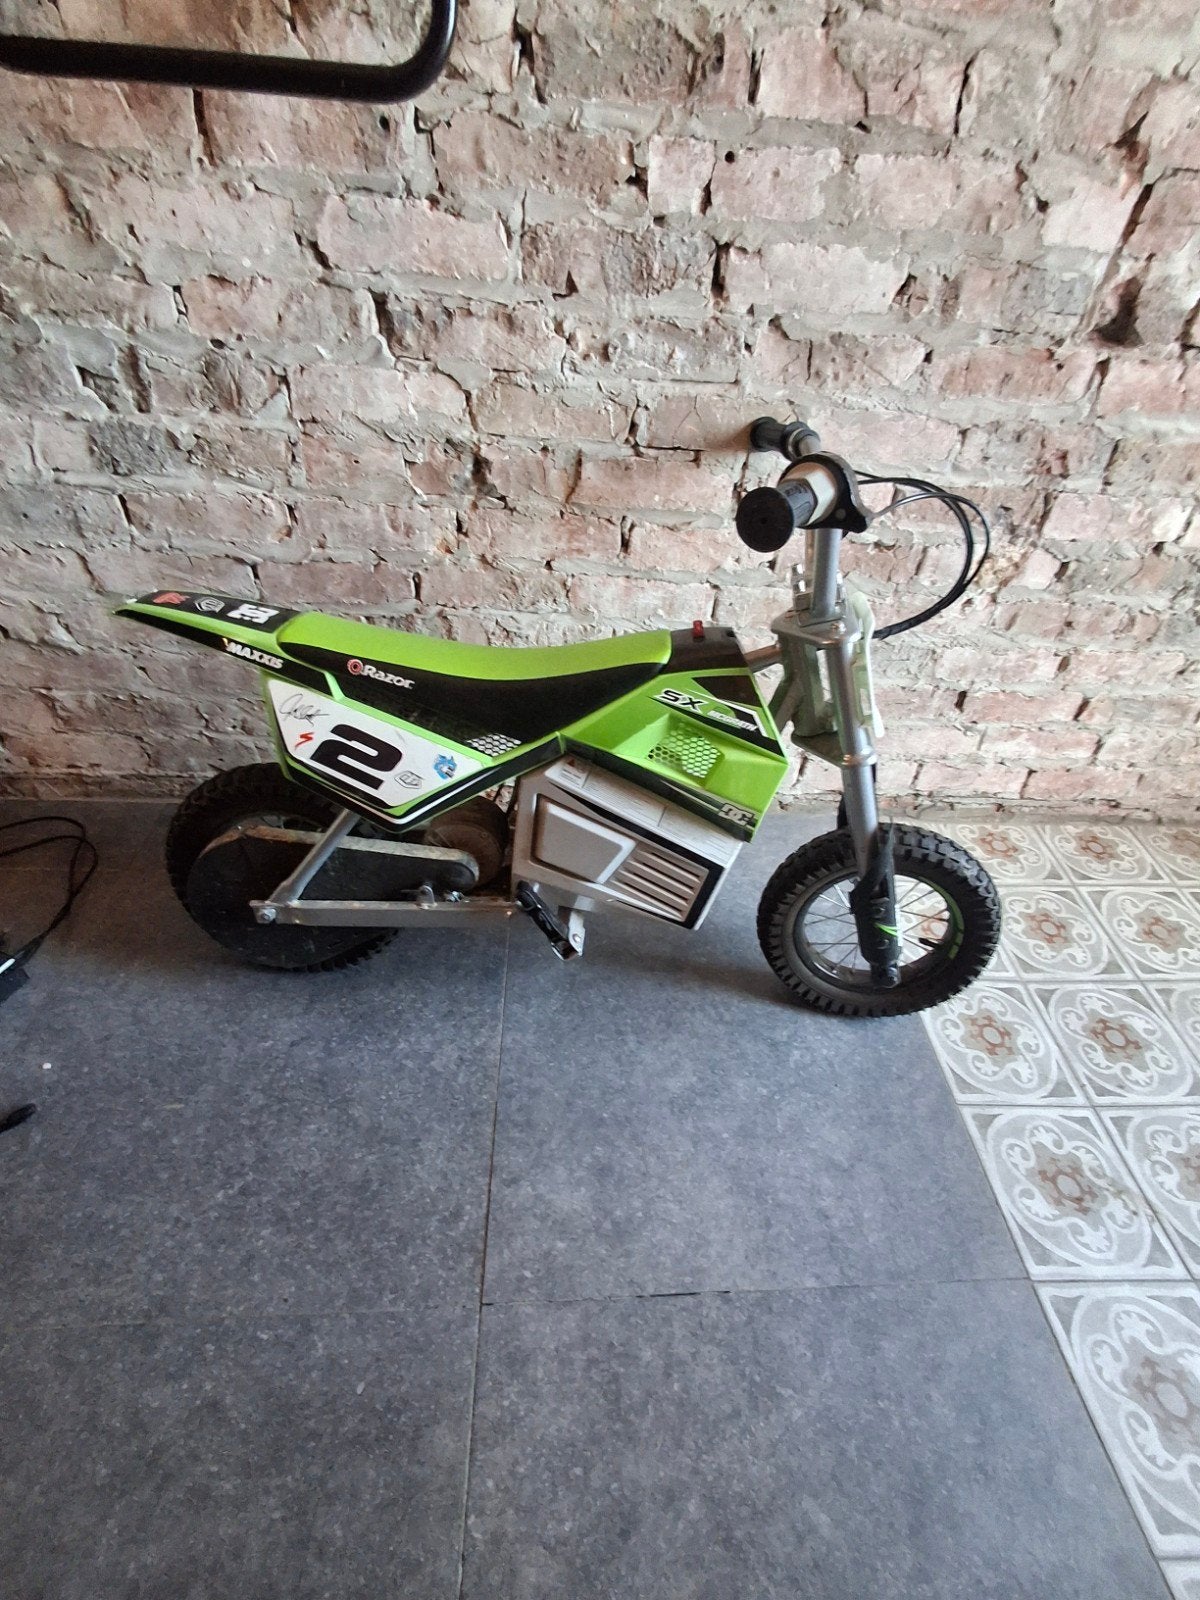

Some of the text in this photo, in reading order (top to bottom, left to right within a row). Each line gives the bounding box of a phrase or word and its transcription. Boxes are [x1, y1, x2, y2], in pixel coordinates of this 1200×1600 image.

[225, 641, 284, 669] MAXXIS
[361, 664, 416, 690] Razor
[656, 687, 708, 714] SX
[309, 723, 403, 791] 2
